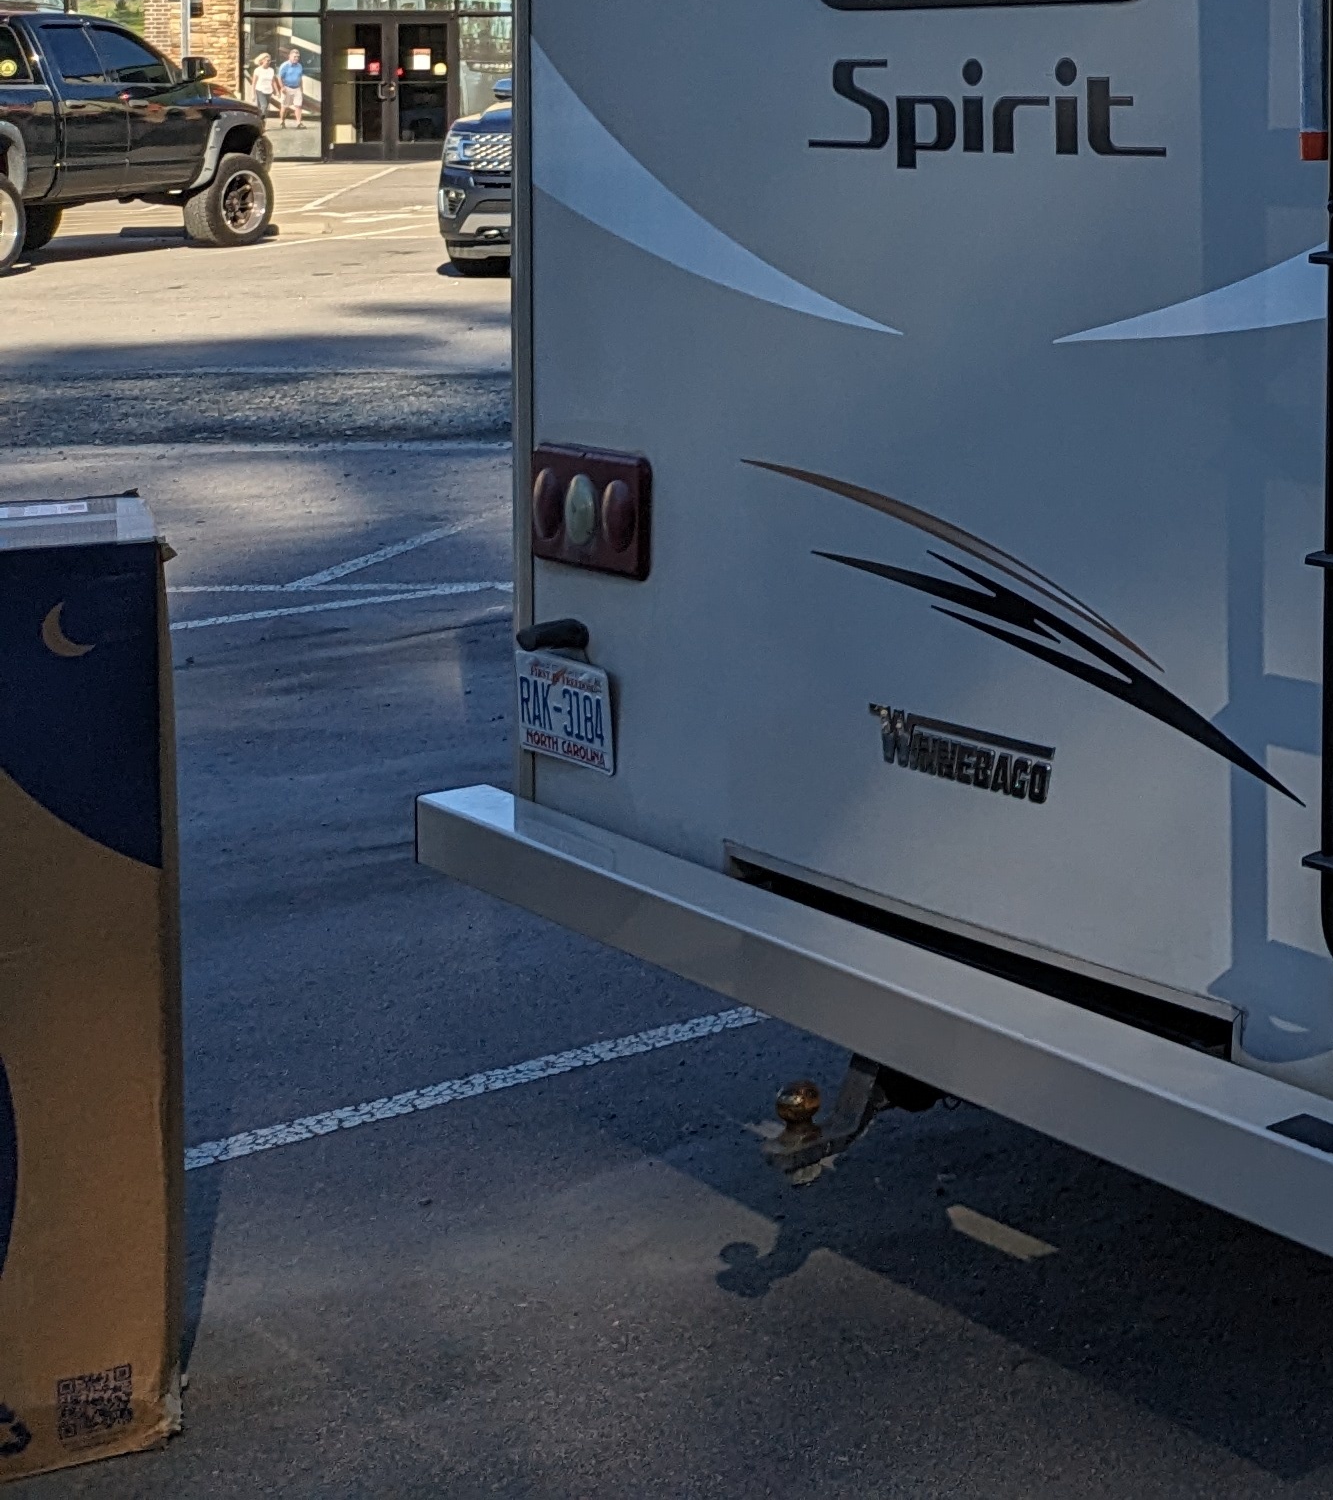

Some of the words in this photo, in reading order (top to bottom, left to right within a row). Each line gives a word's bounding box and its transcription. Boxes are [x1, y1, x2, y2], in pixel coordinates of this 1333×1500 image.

[808, 57, 1167, 169] Spirit
[519, 675, 605, 747] RAK-3184
[526, 728, 559, 752] NORTH
[561, 740, 606, 768] CAROLINA
[868, 702, 1056, 804] WINNEBAGO
